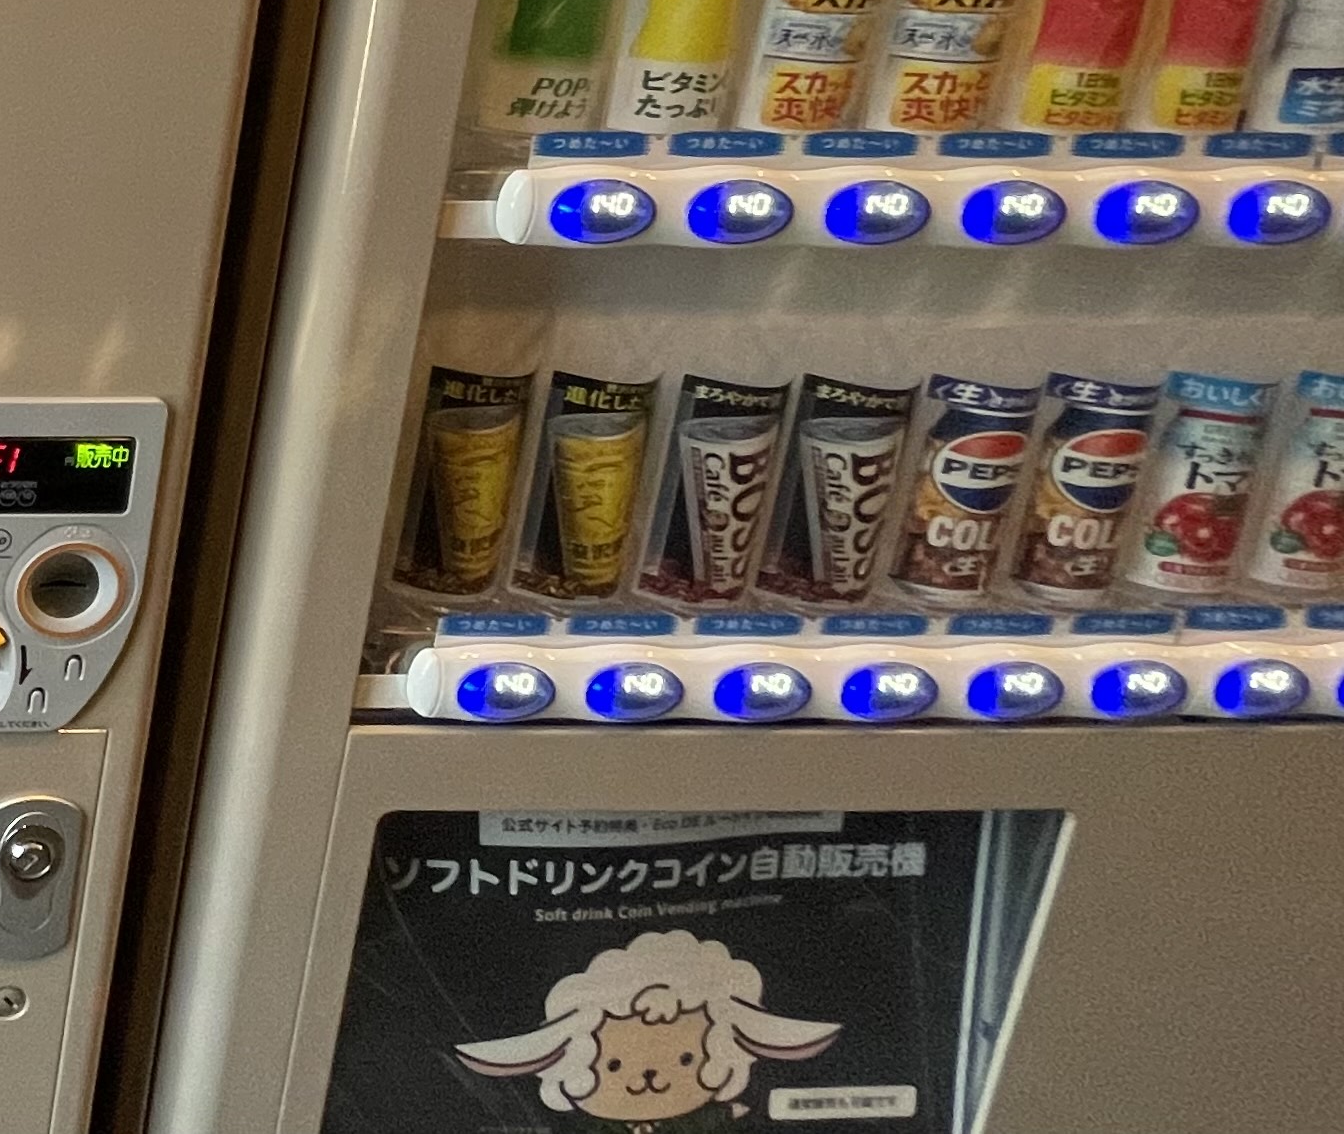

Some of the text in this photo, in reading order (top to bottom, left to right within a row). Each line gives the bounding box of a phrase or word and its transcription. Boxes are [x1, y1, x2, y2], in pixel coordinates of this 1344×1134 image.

[75, 443, 130, 468] 販売中
[385, 841, 926, 896] ソフトドリンクコイン自動販売機
[534, 905, 568, 923] Soft
[571, 903, 615, 922] drink
[617, 902, 653, 920] Coin
